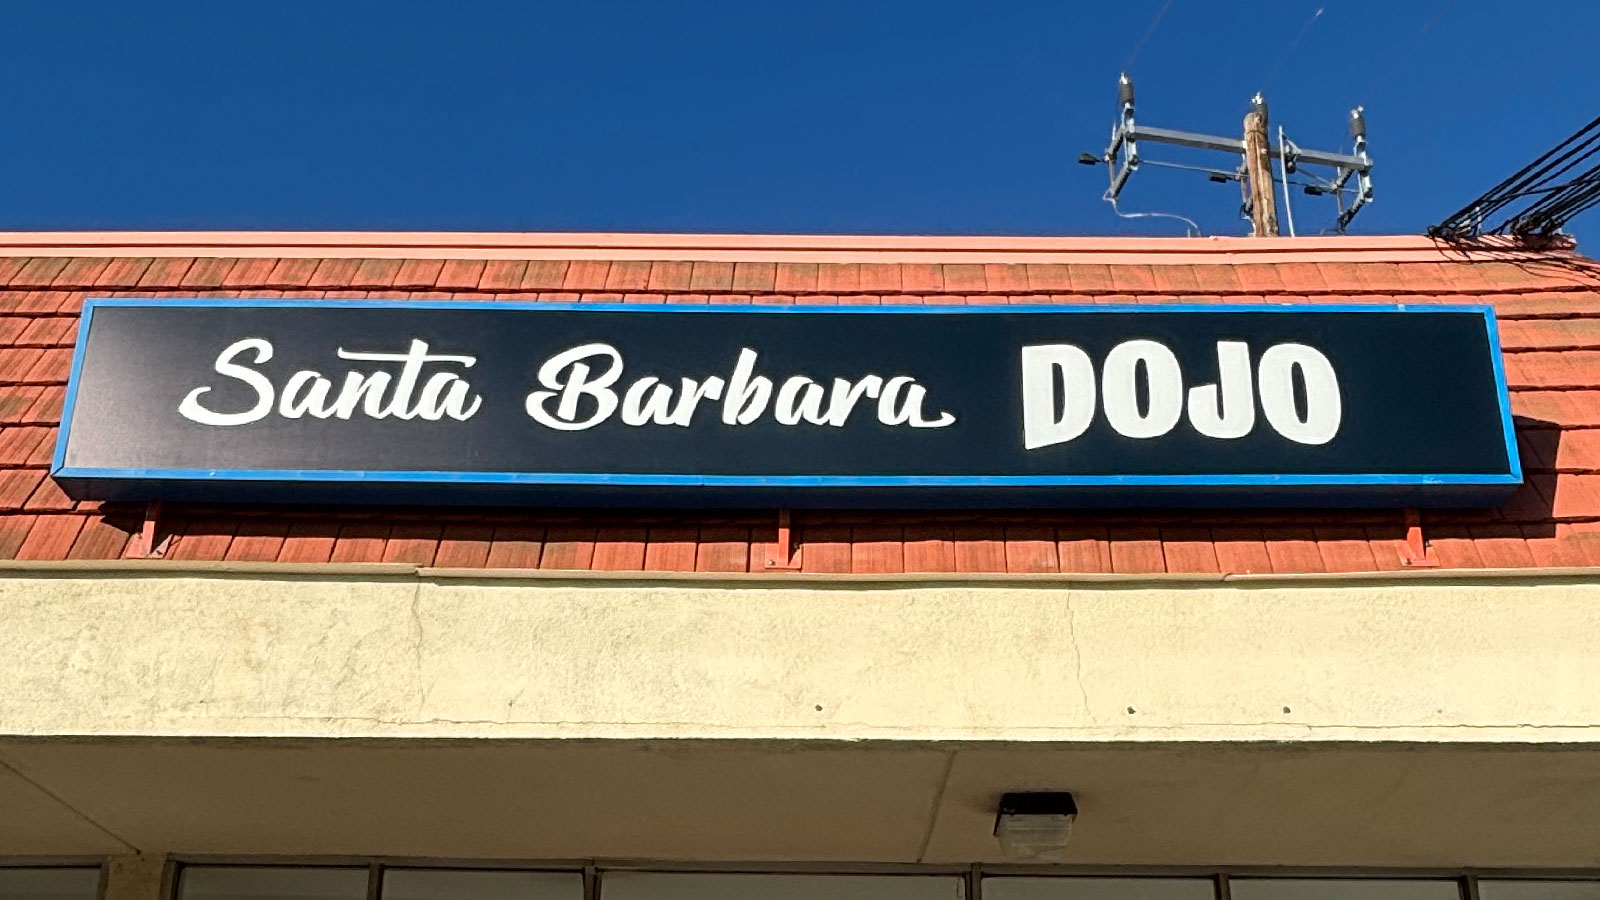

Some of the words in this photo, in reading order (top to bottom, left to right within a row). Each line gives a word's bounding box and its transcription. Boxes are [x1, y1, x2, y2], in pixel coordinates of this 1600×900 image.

[178, 338, 482, 427] Santa
[525, 343, 956, 431] Barbara
[1021, 338, 1342, 450] DOJO
